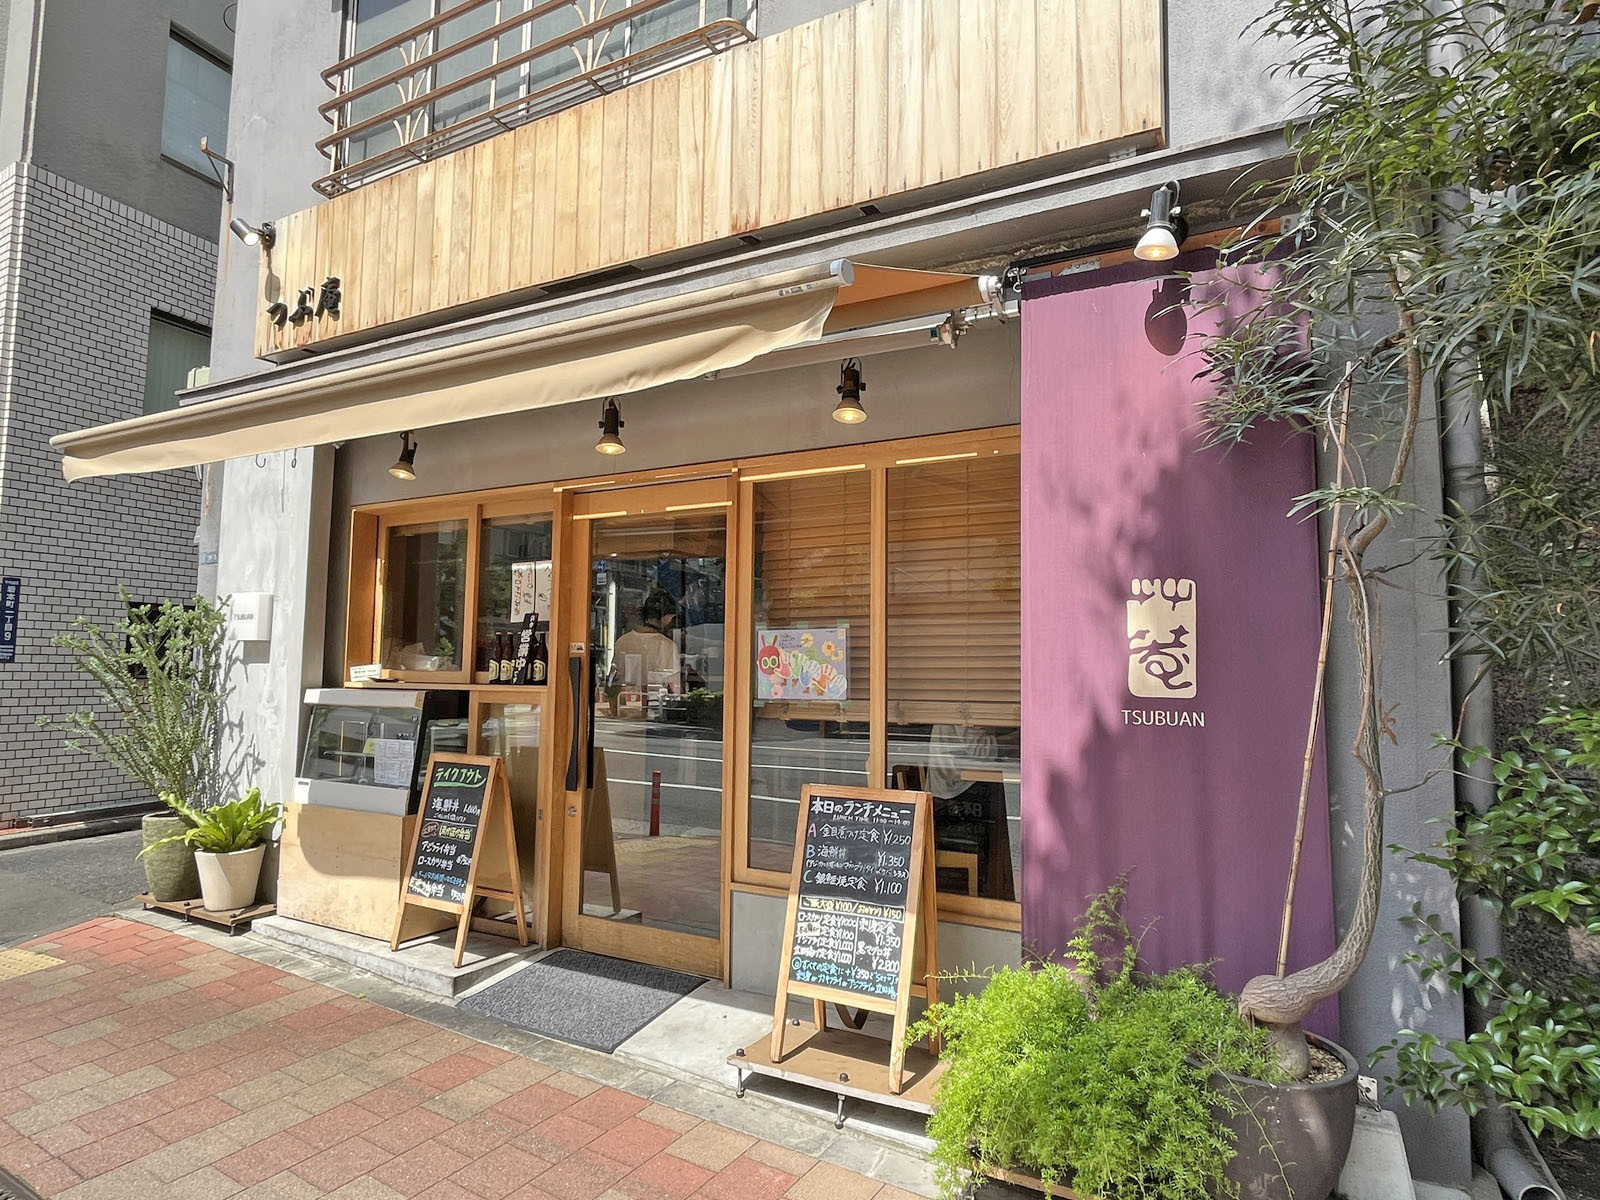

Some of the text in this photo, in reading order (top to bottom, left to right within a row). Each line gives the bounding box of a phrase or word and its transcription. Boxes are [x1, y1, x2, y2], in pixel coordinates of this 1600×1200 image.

[1121, 709, 1205, 727] TSUBUAN
[435, 768, 482, 783] テイクアウト
[810, 797, 911, 819] 本日のランチメニュー
[807, 823, 817, 838] A
[807, 845, 815, 859] B
[803, 870, 813, 883] C
